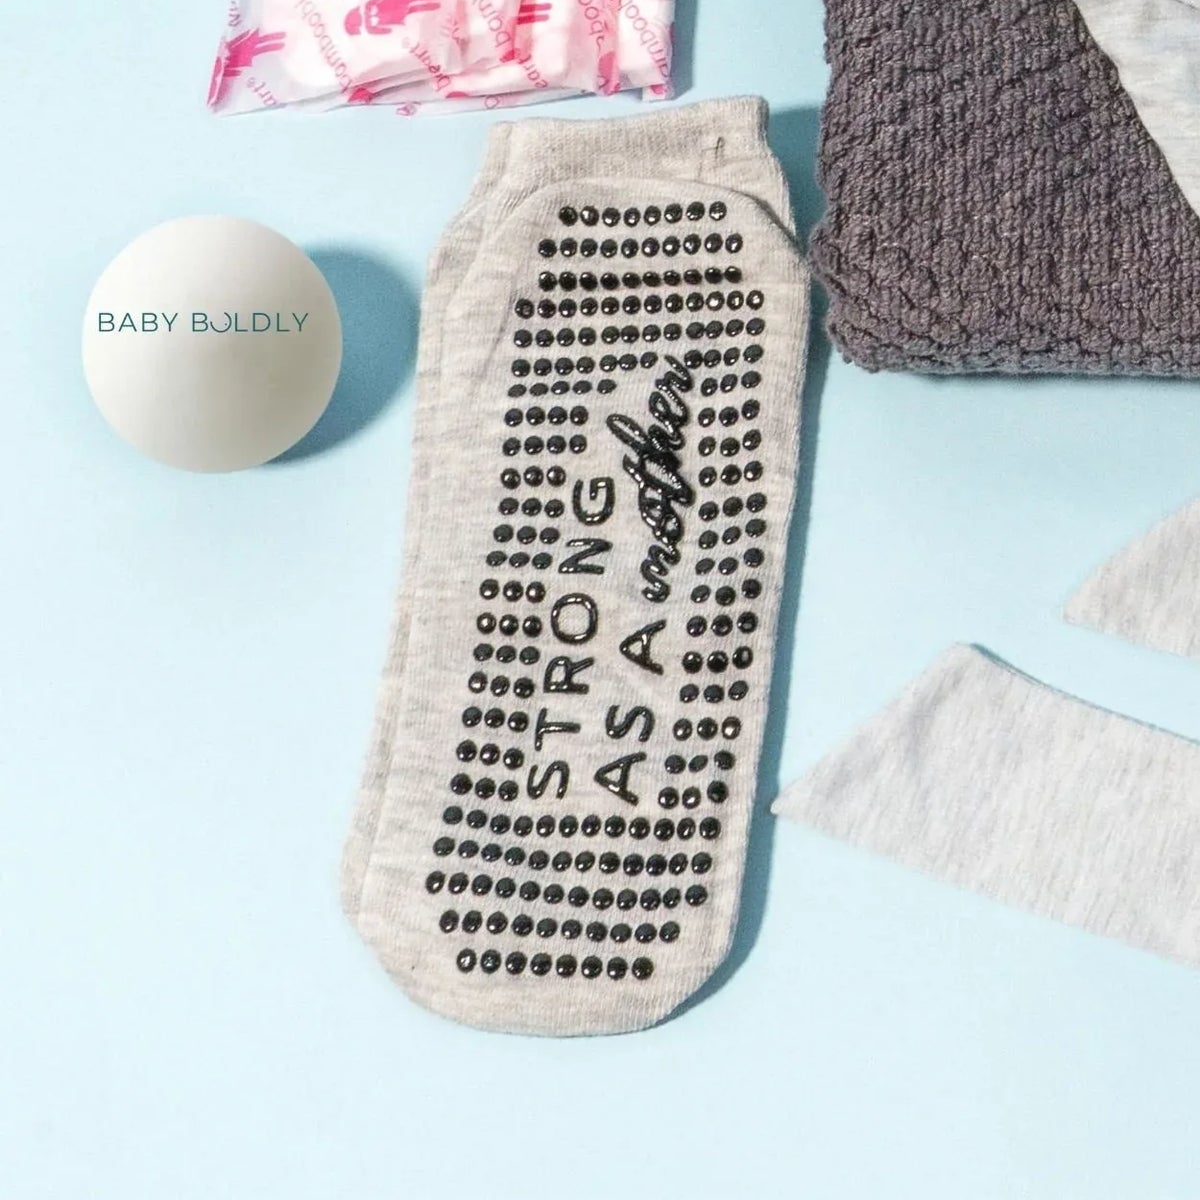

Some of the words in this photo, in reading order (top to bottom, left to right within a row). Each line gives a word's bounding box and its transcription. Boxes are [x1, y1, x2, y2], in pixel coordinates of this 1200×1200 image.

[98, 311, 179, 333] BABY
[191, 311, 309, 334] BOLDLY
[606, 353, 696, 603] mother
[526, 475, 615, 800] STRONG
[619, 618, 669, 676] A
[593, 704, 656, 807] AS
